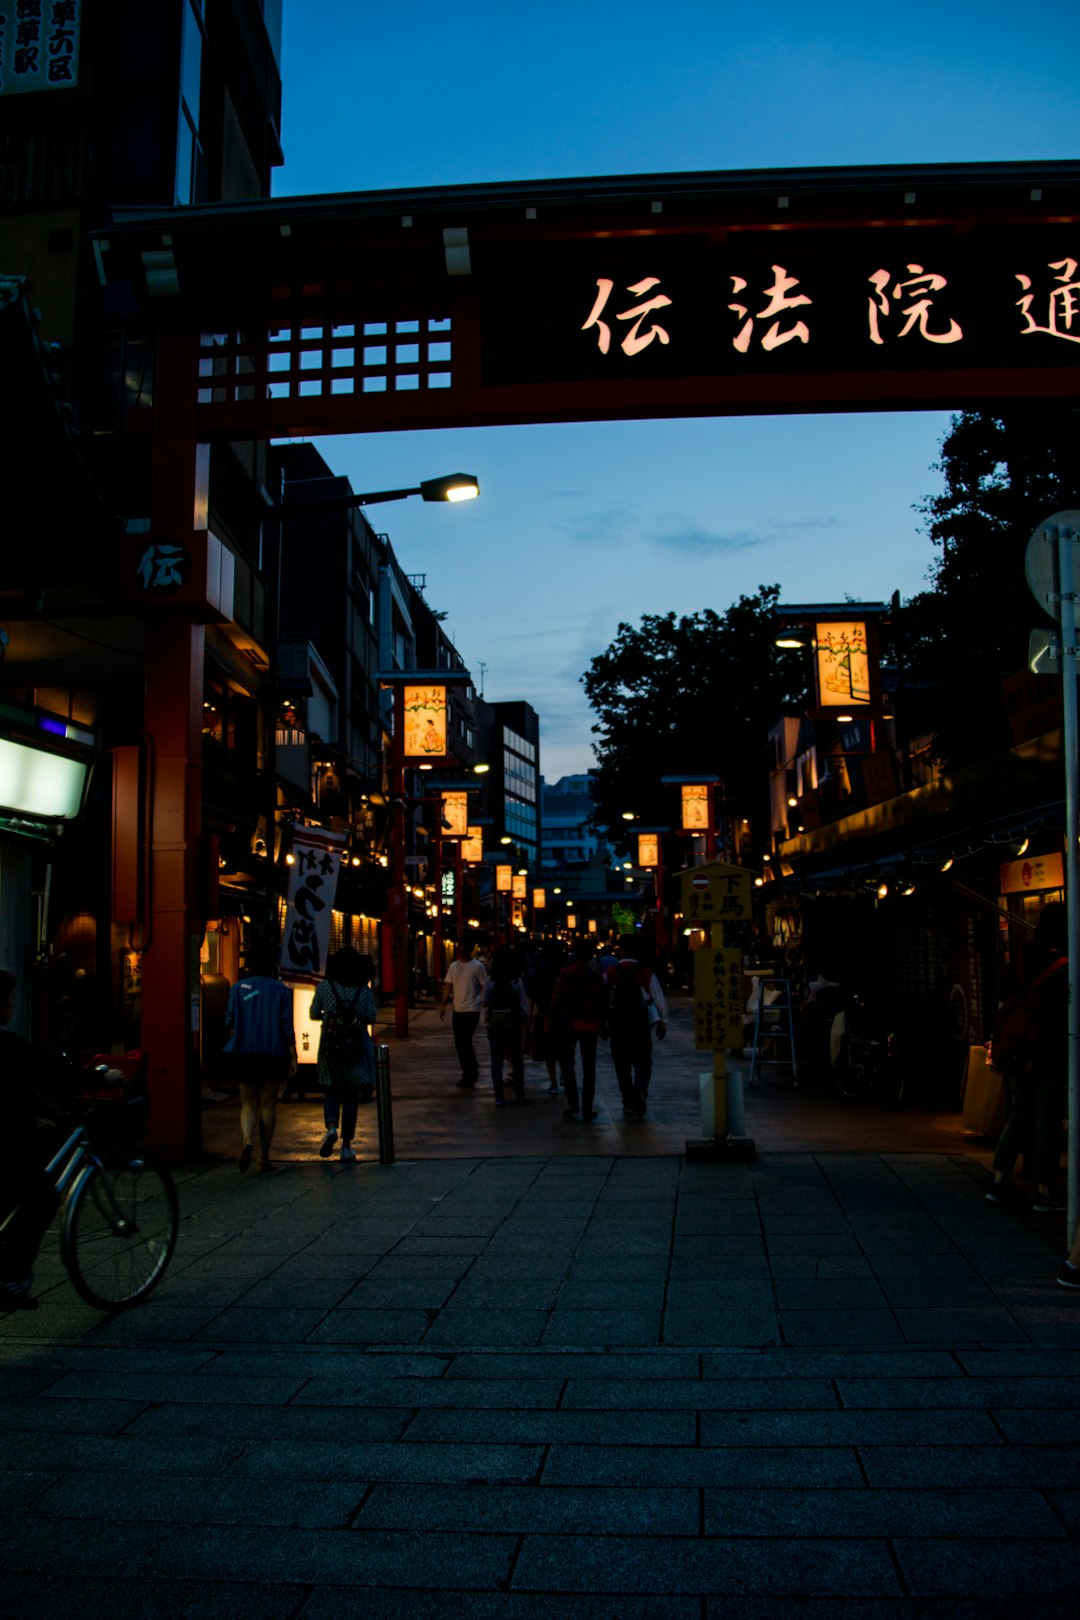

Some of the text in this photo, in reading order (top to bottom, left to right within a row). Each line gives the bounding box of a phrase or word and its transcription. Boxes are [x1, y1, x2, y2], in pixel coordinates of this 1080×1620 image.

[581, 256, 1080, 357] 伝法院通
[136, 544, 184, 590] 伝
[718, 874, 744, 917] 下馬
